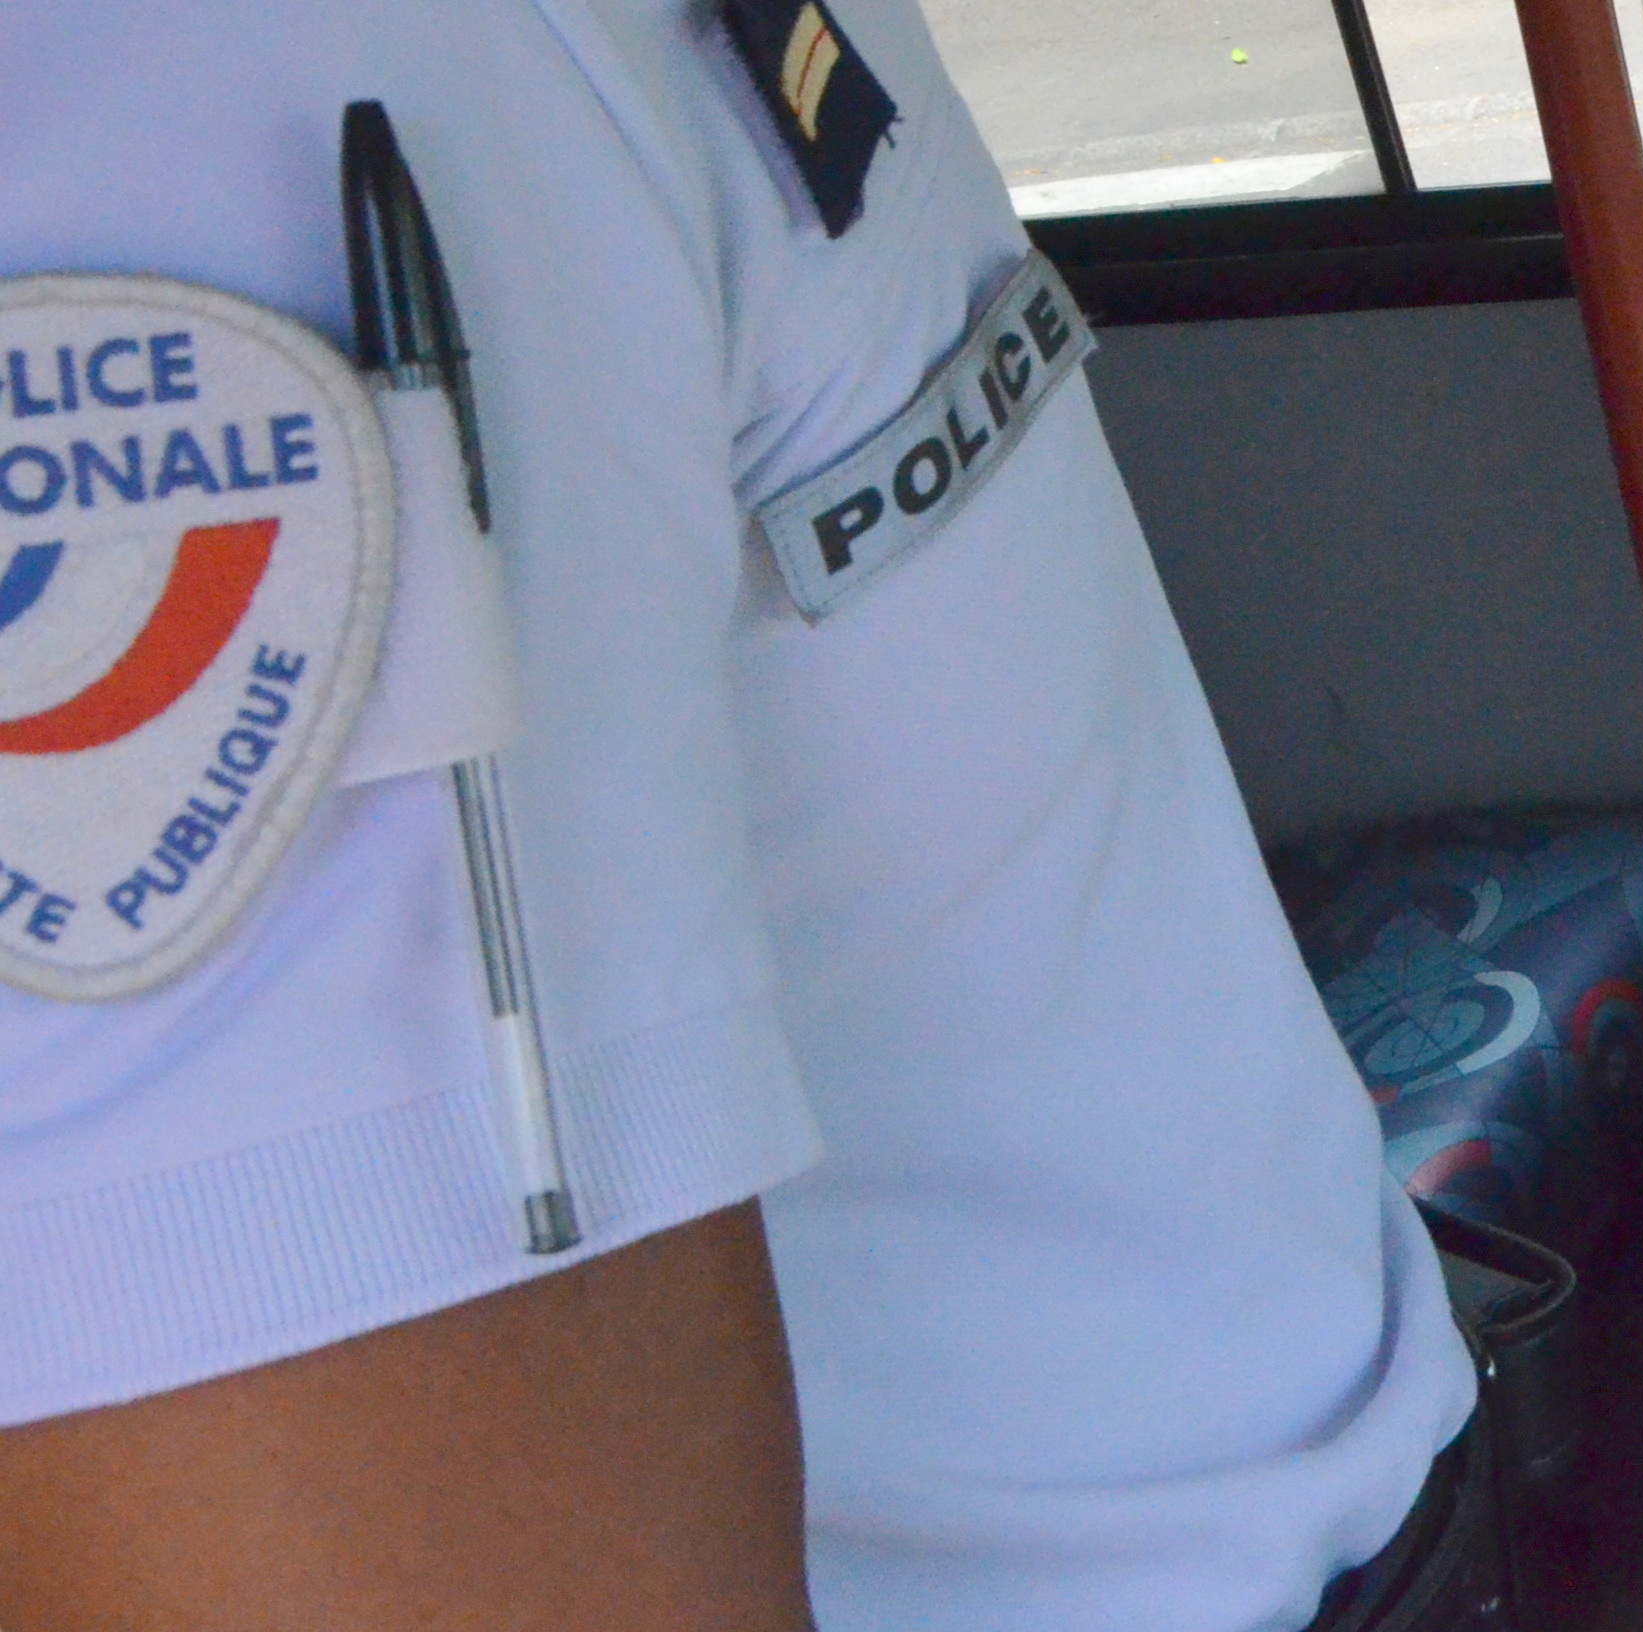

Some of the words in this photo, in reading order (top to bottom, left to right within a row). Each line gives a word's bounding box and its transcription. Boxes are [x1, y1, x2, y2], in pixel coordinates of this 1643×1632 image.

[0, 332, 198, 418] LICE
[811, 285, 1071, 576] POLICE
[0, 860, 77, 944] TE
[105, 643, 306, 931] PUBLIQUE
